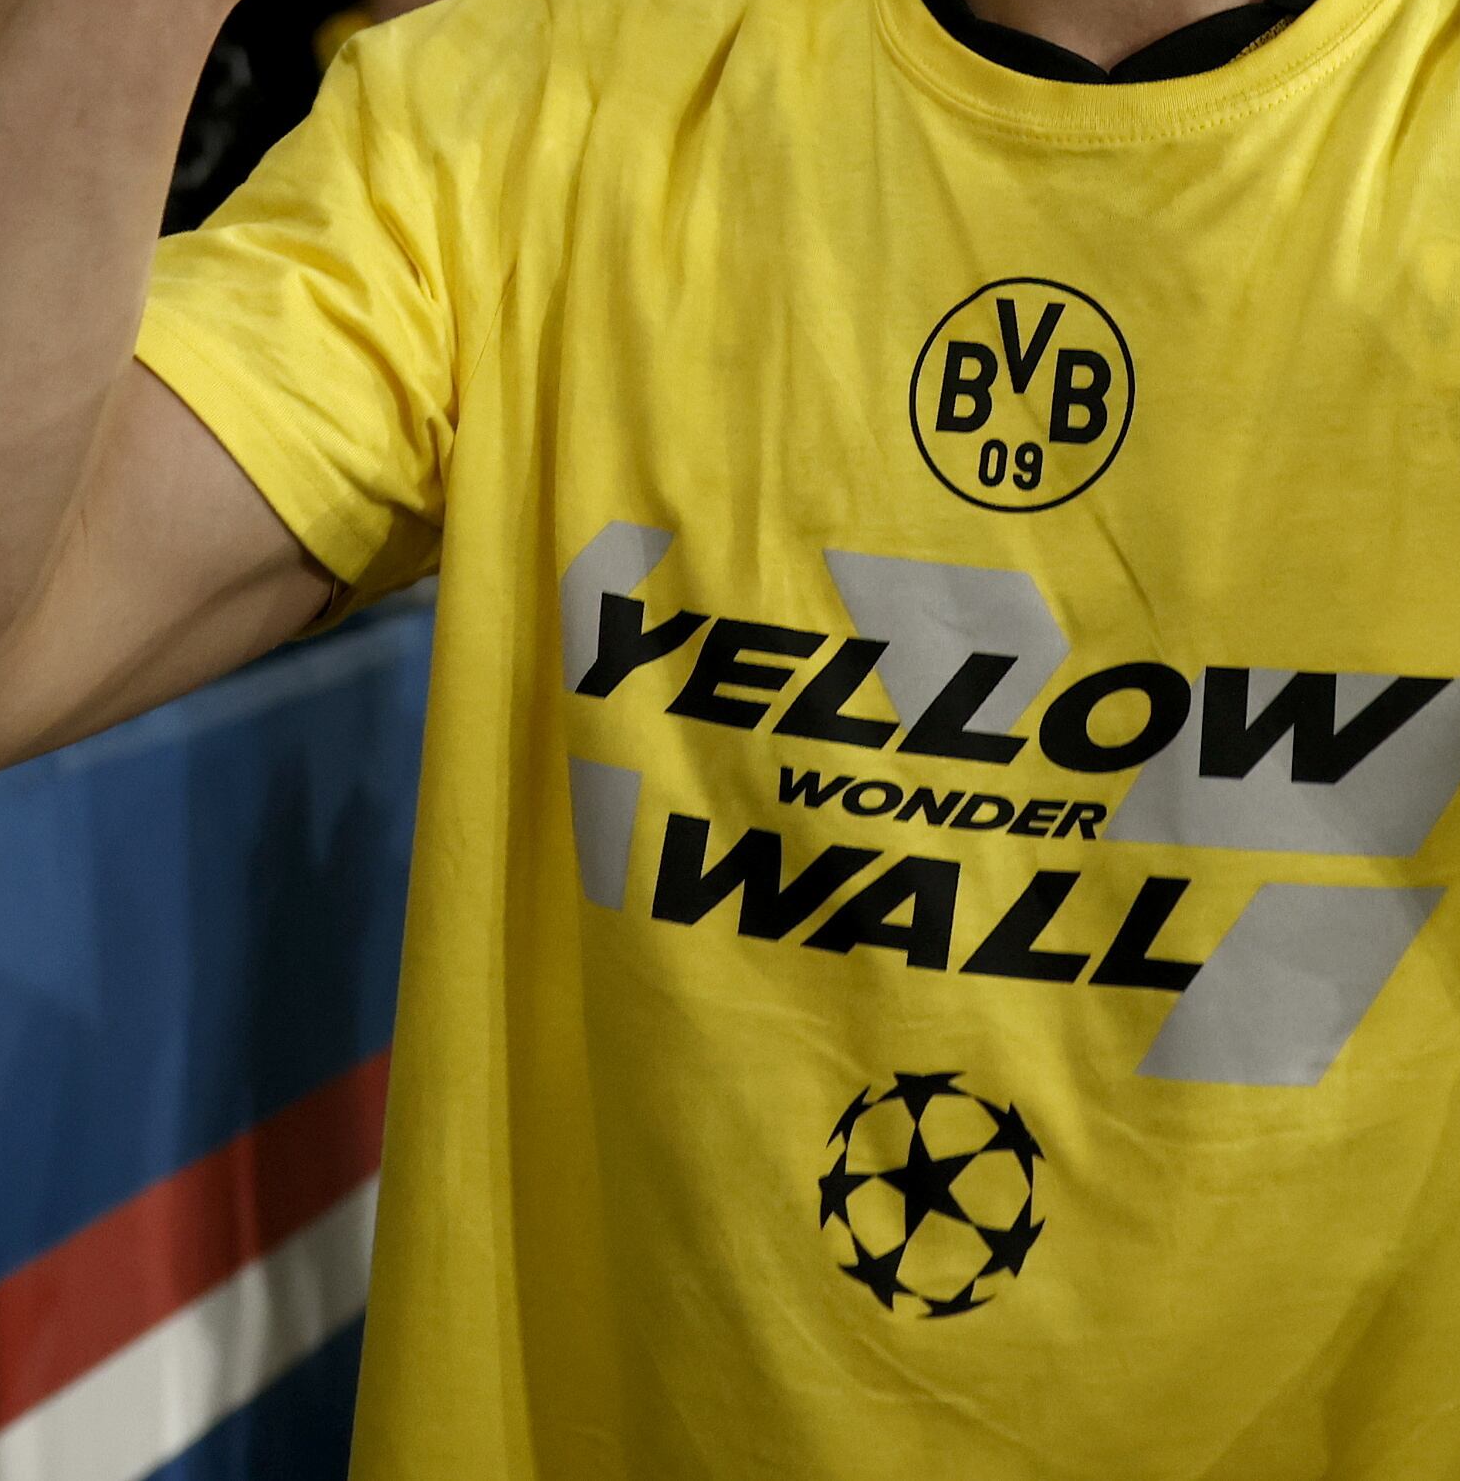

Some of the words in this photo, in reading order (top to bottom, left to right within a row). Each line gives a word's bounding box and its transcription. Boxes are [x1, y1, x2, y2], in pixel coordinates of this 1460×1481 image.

[934, 297, 1113, 445] BVB
[977, 438, 1044, 492] 09
[573, 591, 1454, 785] YELLOW
[777, 765, 1108, 841] WONDER
[650, 812, 1204, 994] WALL
